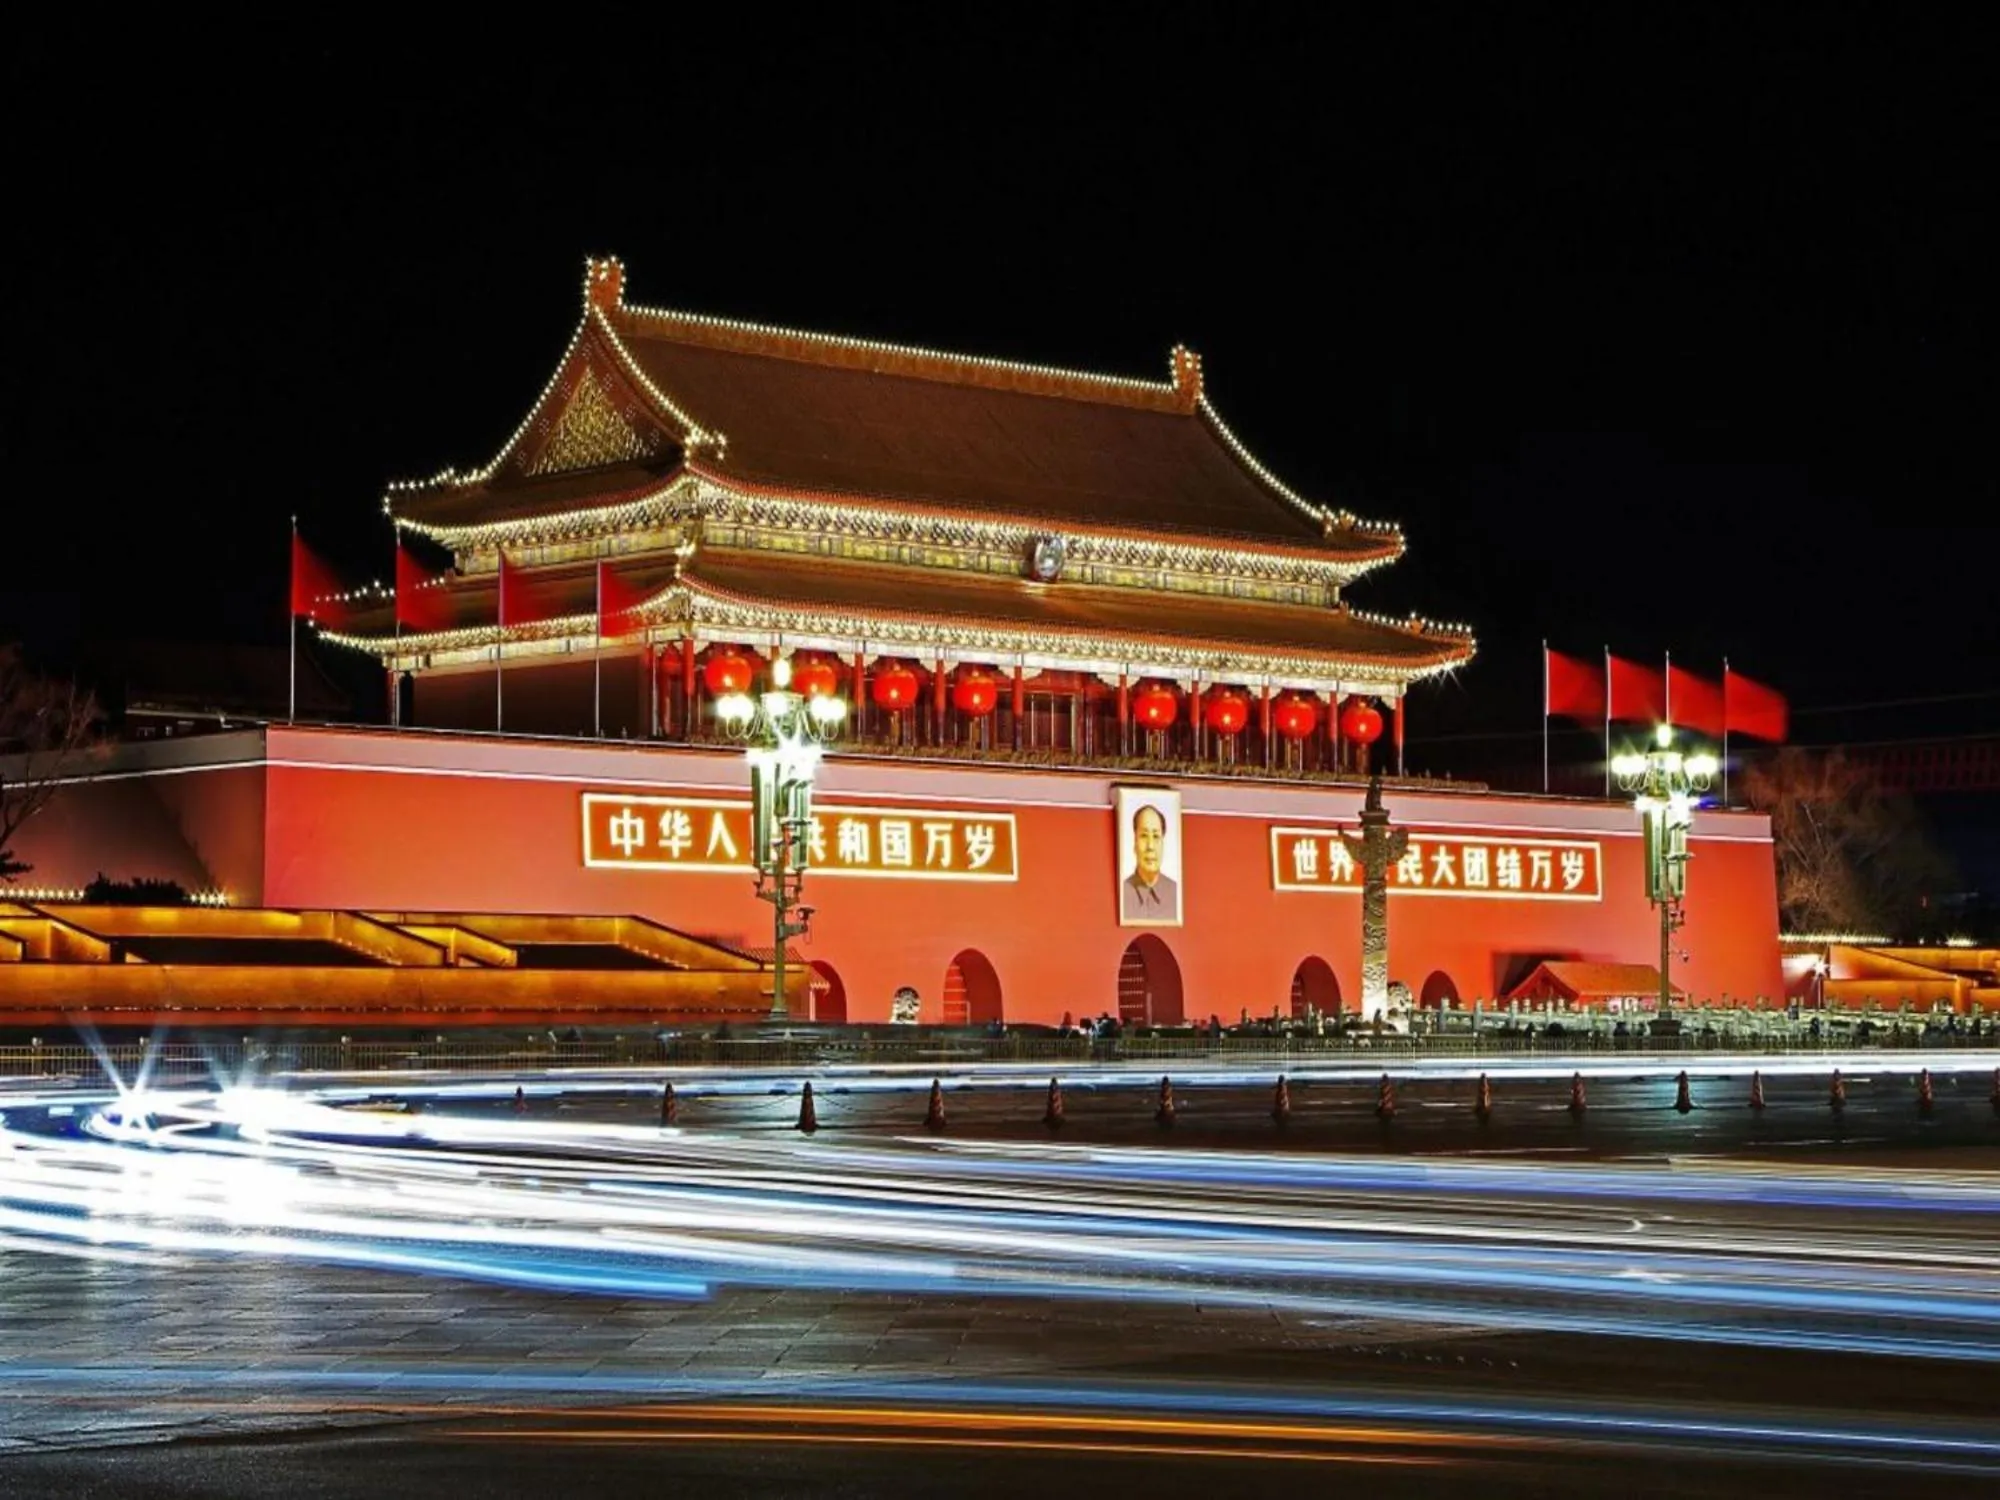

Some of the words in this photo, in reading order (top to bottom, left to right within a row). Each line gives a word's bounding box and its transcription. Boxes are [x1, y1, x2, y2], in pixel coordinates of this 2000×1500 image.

[609, 808, 995, 869] 中华人共和国万岁
[1293, 838, 1585, 891] 世界民大团结万岁
